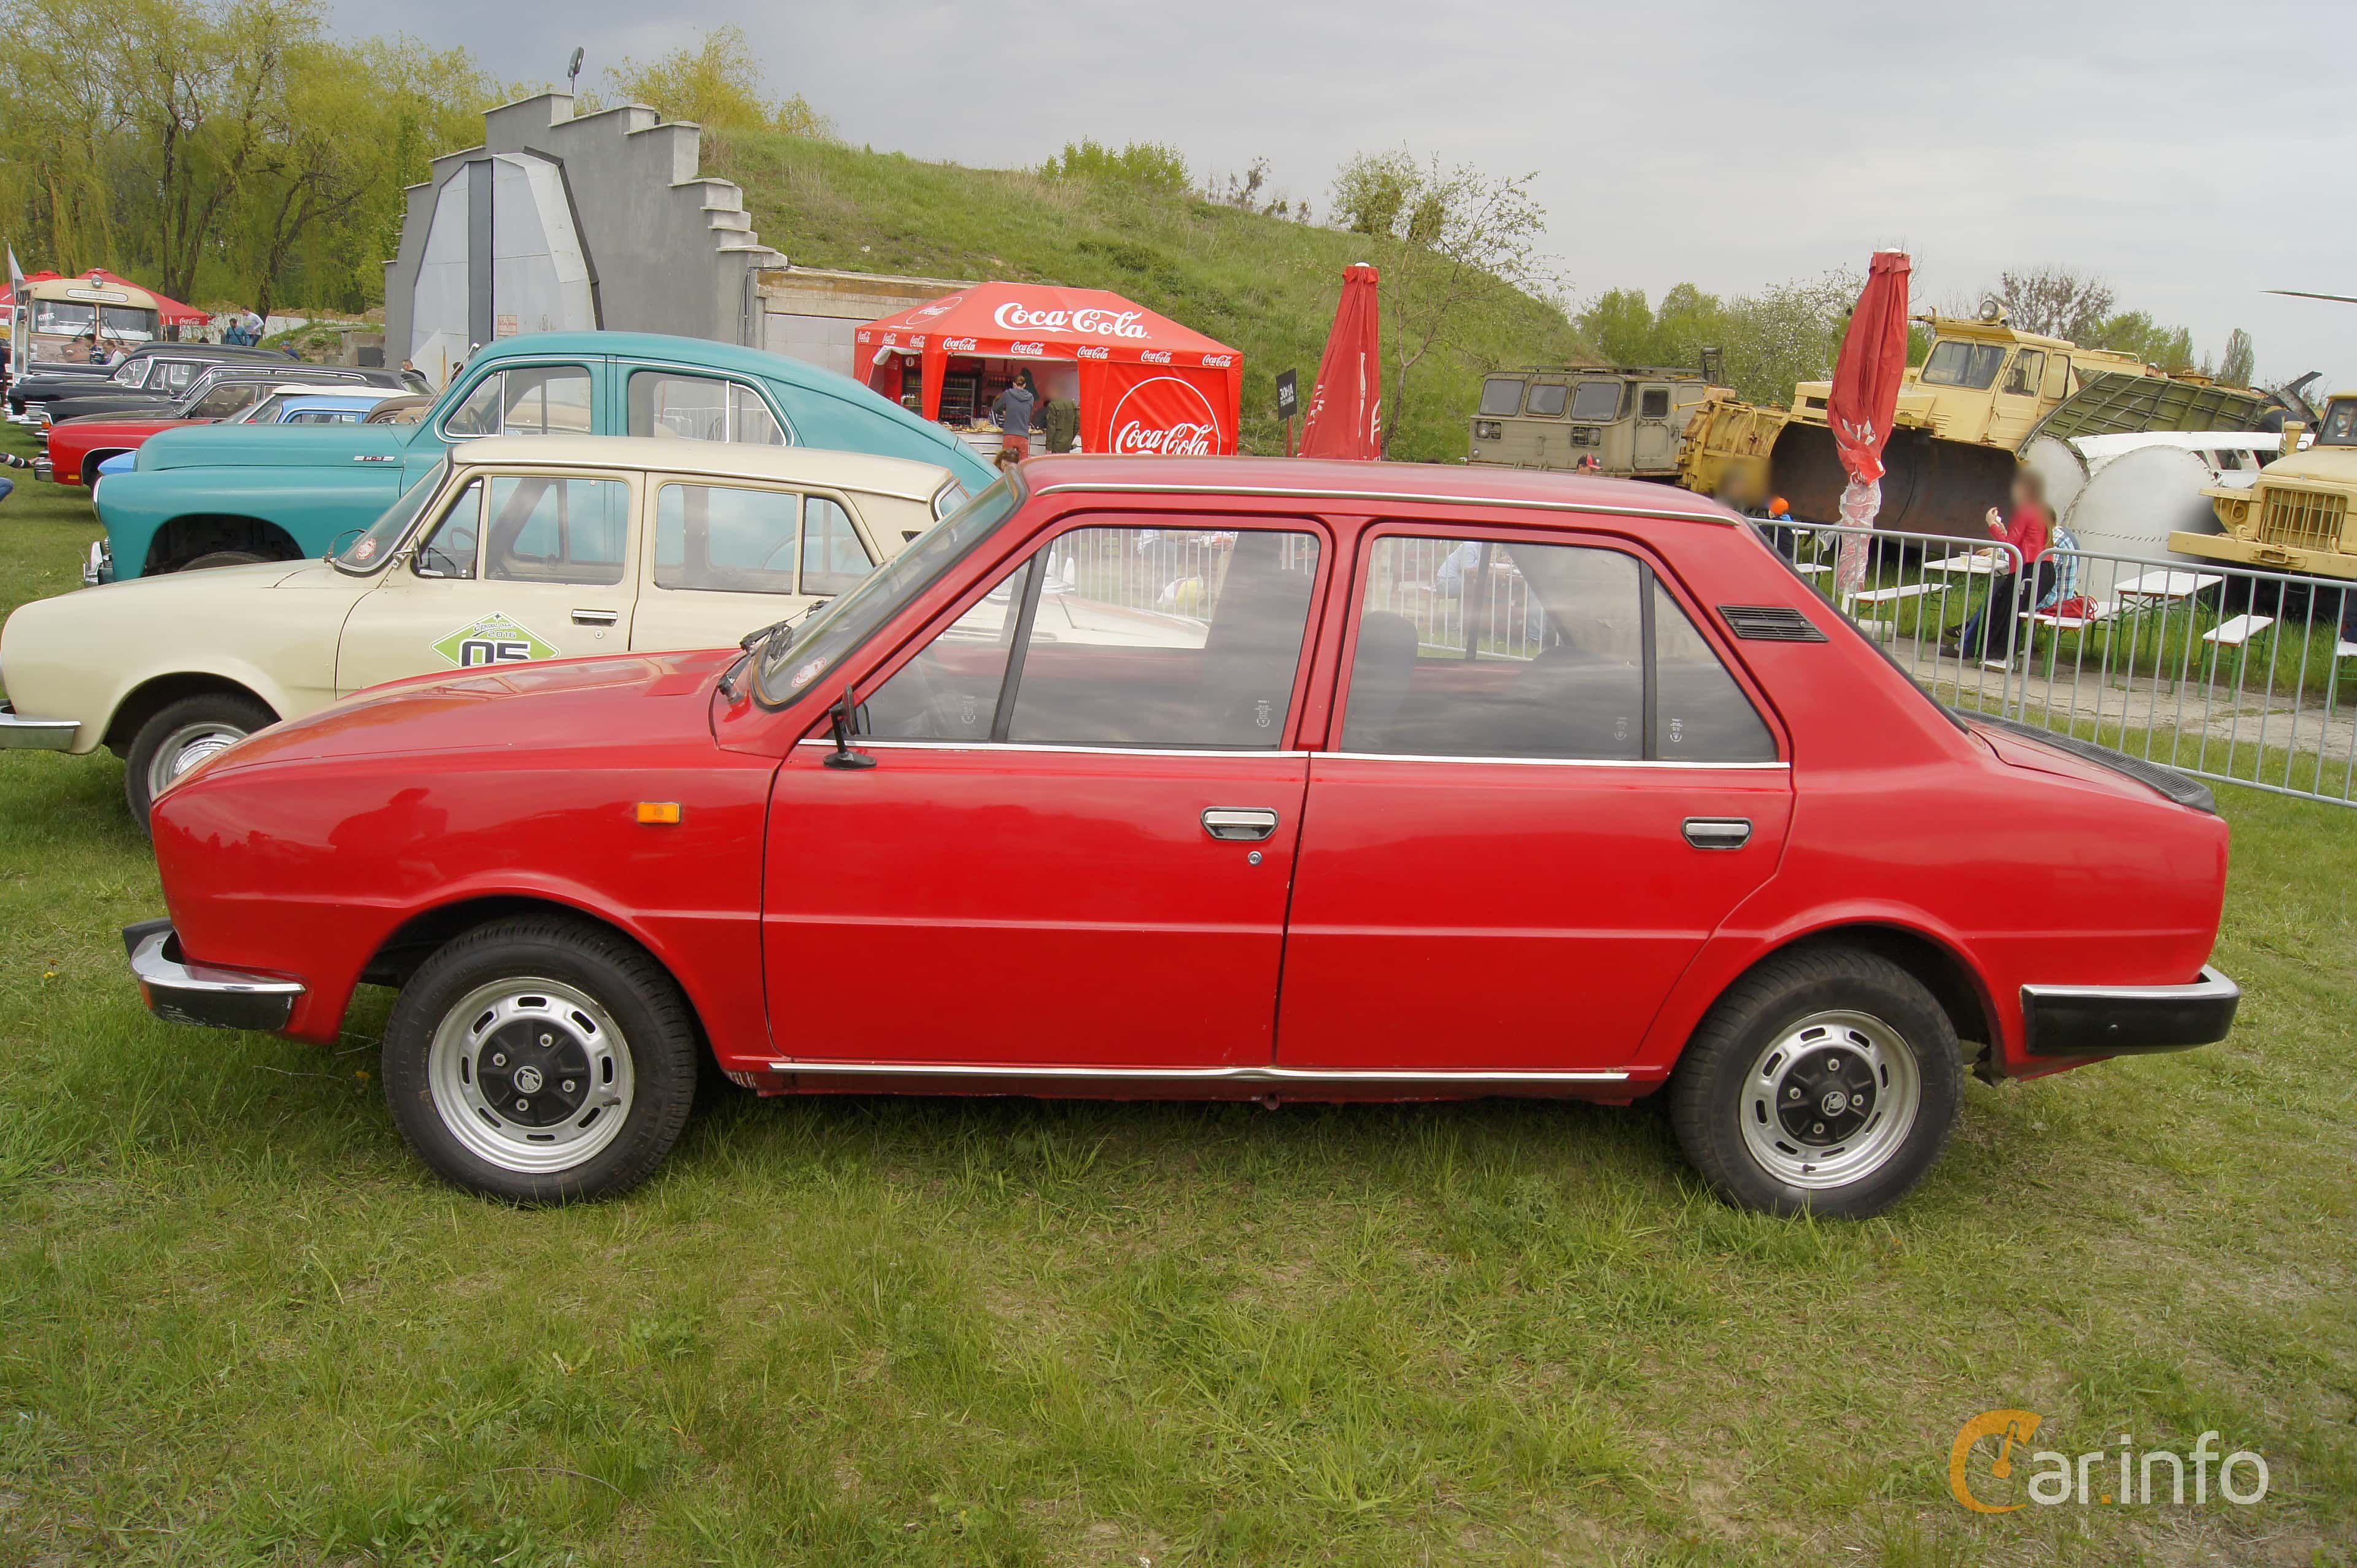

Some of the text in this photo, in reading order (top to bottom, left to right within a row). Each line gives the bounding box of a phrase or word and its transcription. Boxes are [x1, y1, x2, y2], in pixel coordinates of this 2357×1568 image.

[994, 303, 1147, 338] Coca-Cola
[943, 337, 977, 351] Coca-Cola
[1011, 341, 1045, 355] Coca-Cola
[1077, 346, 1110, 359] Coca-Cola
[1140, 350, 1172, 363] Coca-Cola
[1202, 353, 1233, 367] Coca-Cola
[1280, 383, 1293, 400] ЗОНА
[1115, 420, 1213, 455] Coca-Cola
